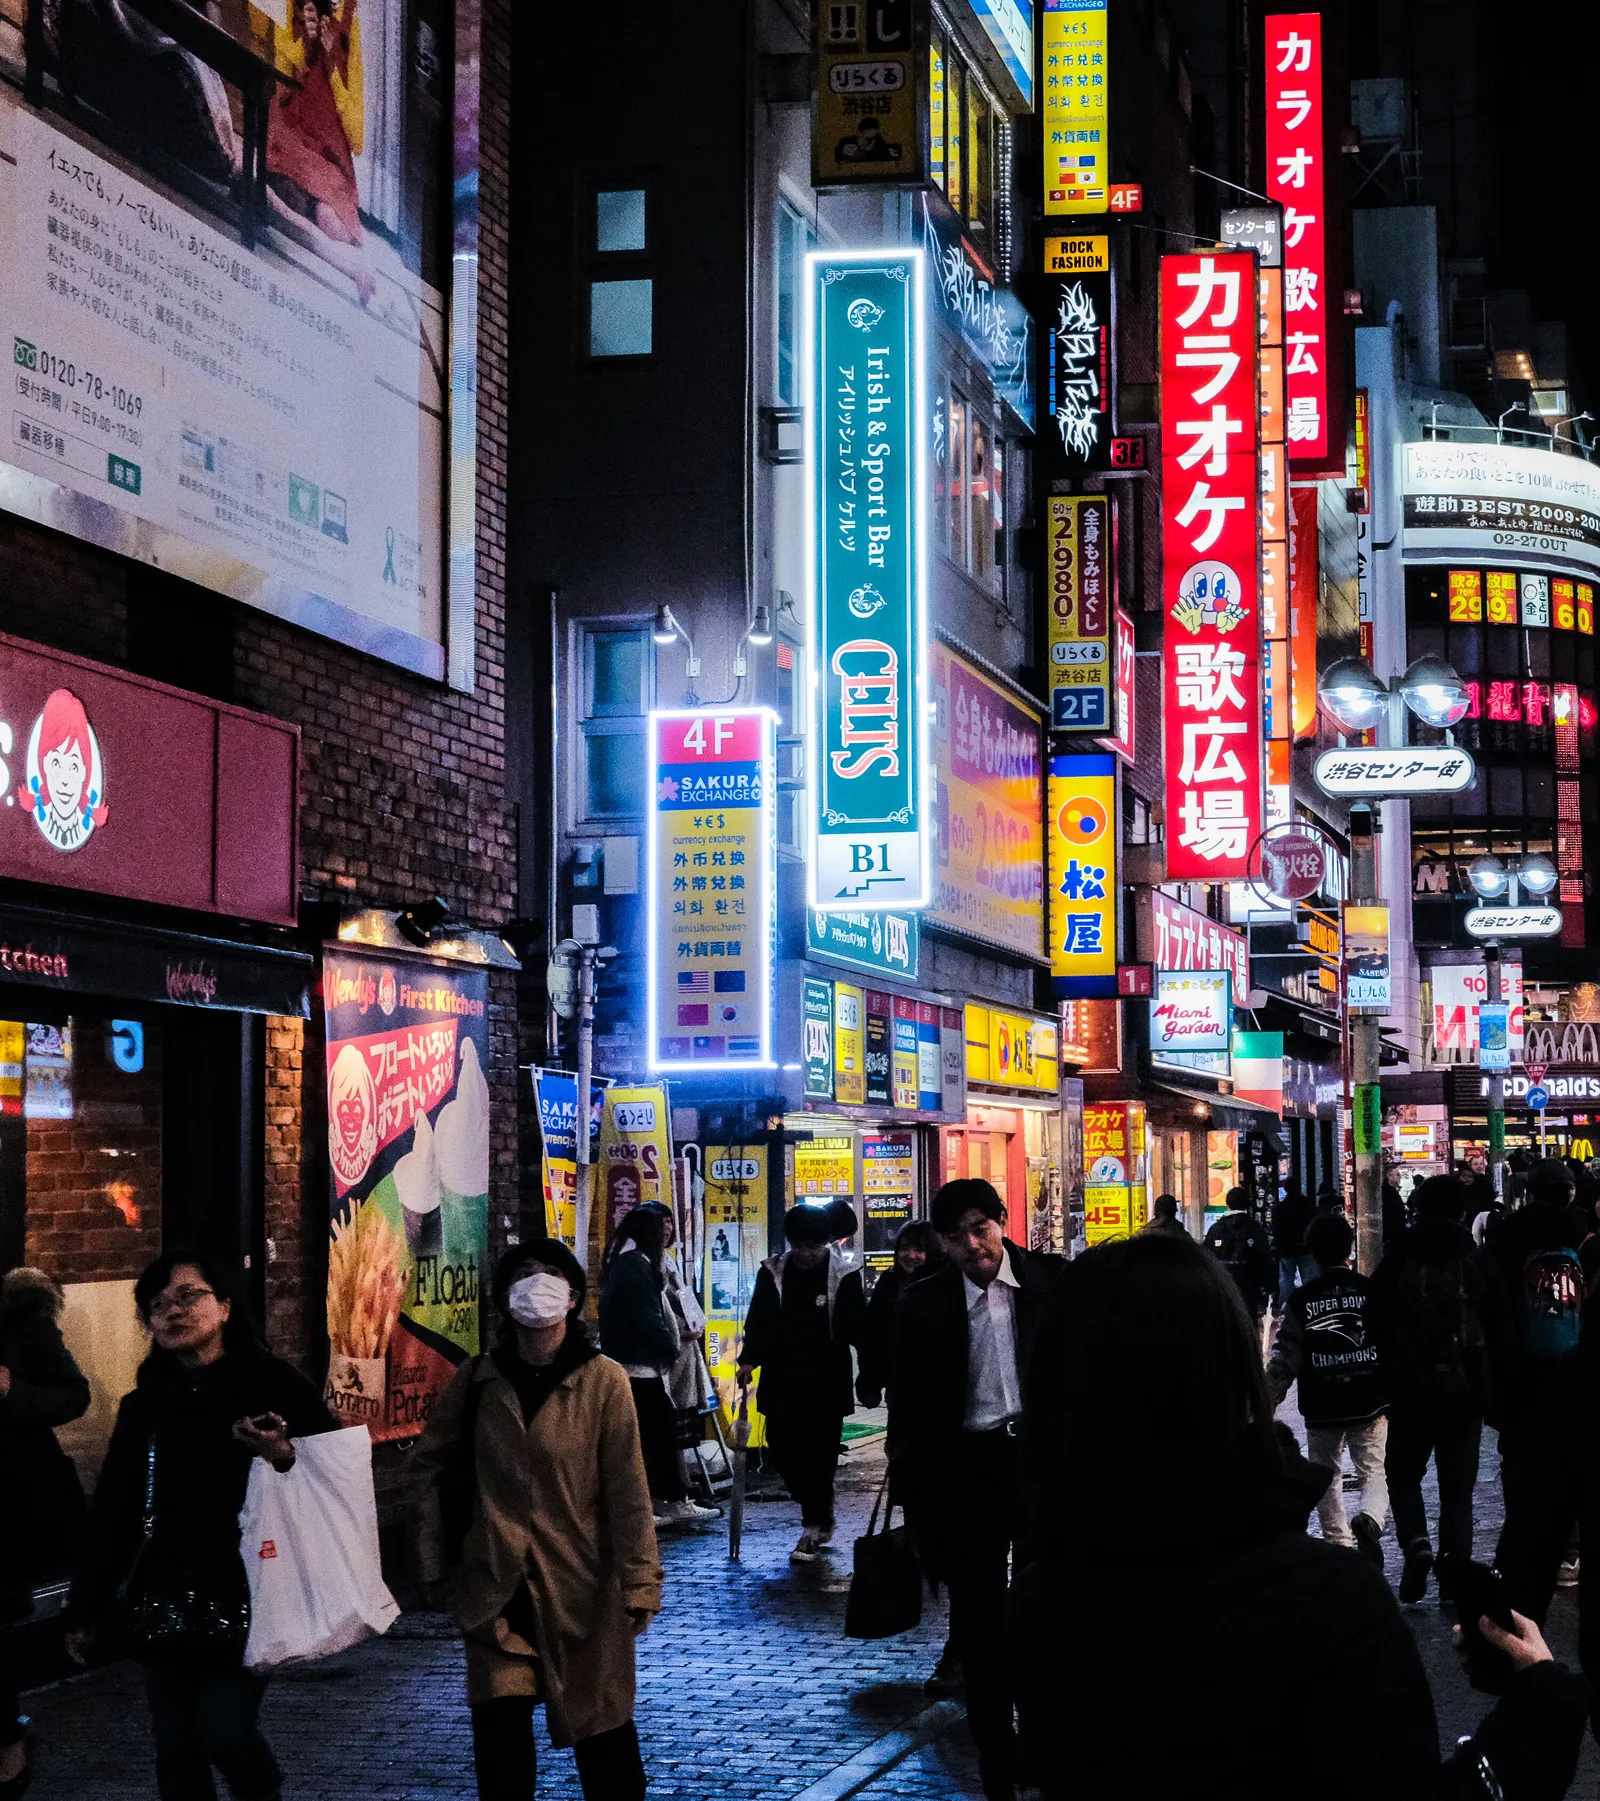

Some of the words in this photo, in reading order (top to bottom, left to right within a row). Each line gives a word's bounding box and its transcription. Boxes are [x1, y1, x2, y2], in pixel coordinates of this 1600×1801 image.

[834, 66, 899, 88] りらくる
[1051, 130, 1101, 145] 外貨両替
[1111, 190, 1138, 208] 4F
[1225, 220, 1275, 235] センター街
[1061, 240, 1093, 254] ROCK
[1052, 257, 1102, 270] FASHION
[40, 351, 143, 418] 0120-78-1069
[867, 346, 891, 414] Irish
[1175, 257, 1246, 553] カラオケ
[868, 423, 891, 437] &
[1116, 442, 1140, 463] 3F
[113, 463, 136, 487] 検索
[861, 443, 891, 518] Sport
[1053, 503, 1072, 515] 60分
[1461, 499, 1526, 516] BEST
[838, 501, 857, 552] ケルツ
[867, 525, 892, 568] Bar
[1493, 532, 1538, 548] 02-27
[1540, 537, 1568, 552] OUT
[1083, 507, 1100, 631] 全身もみほぐし
[1451, 574, 1516, 590] 飲み放題
[1525, 603, 1537, 616] 金
[1538, 578, 1548, 624] やきとり
[1056, 648, 1101, 660] りらくる
[1056, 669, 1102, 683] 渋谷店
[831, 638, 900, 779] CELTS
[1062, 695, 1098, 719] 2F
[683, 717, 735, 755] 4F
[1174, 643, 1249, 860] 歌広場
[1323, 760, 1465, 780] 渋谷センター街
[681, 774, 763, 790] SAKURA
[681, 790, 751, 802] EXCHANGE
[672, 836, 707, 846] currency
[709, 834, 746, 843] exchange
[673, 853, 746, 868] 外币兑换
[848, 844, 892, 873] B1
[673, 875, 746, 892] 外幣兌換
[673, 898, 705, 917] 외화
[714, 896, 747, 916] 환전
[1059, 859, 1107, 955] 松屋
[1470, 915, 1556, 928] 渋谷センター街
[677, 941, 743, 959] 外貨両替
[1125, 969, 1148, 993] 1F
[1359, 967, 1389, 978] SASEBO
[327, 967, 377, 1014] Wendy's
[400, 984, 433, 1010] First
[434, 989, 484, 1016] Kitchen
[1152, 1003, 1211, 1018] Miami
[370, 1028, 454, 1087] フロートいろいろ
[377, 1057, 455, 1140] ポテトいろいろ
[825, 1138, 848, 1149] WU
[413, 1253, 480, 1307] Float
[1306, 1300, 1338, 1318] SUPER
[1311, 1346, 1377, 1367] CHAMPIONS
